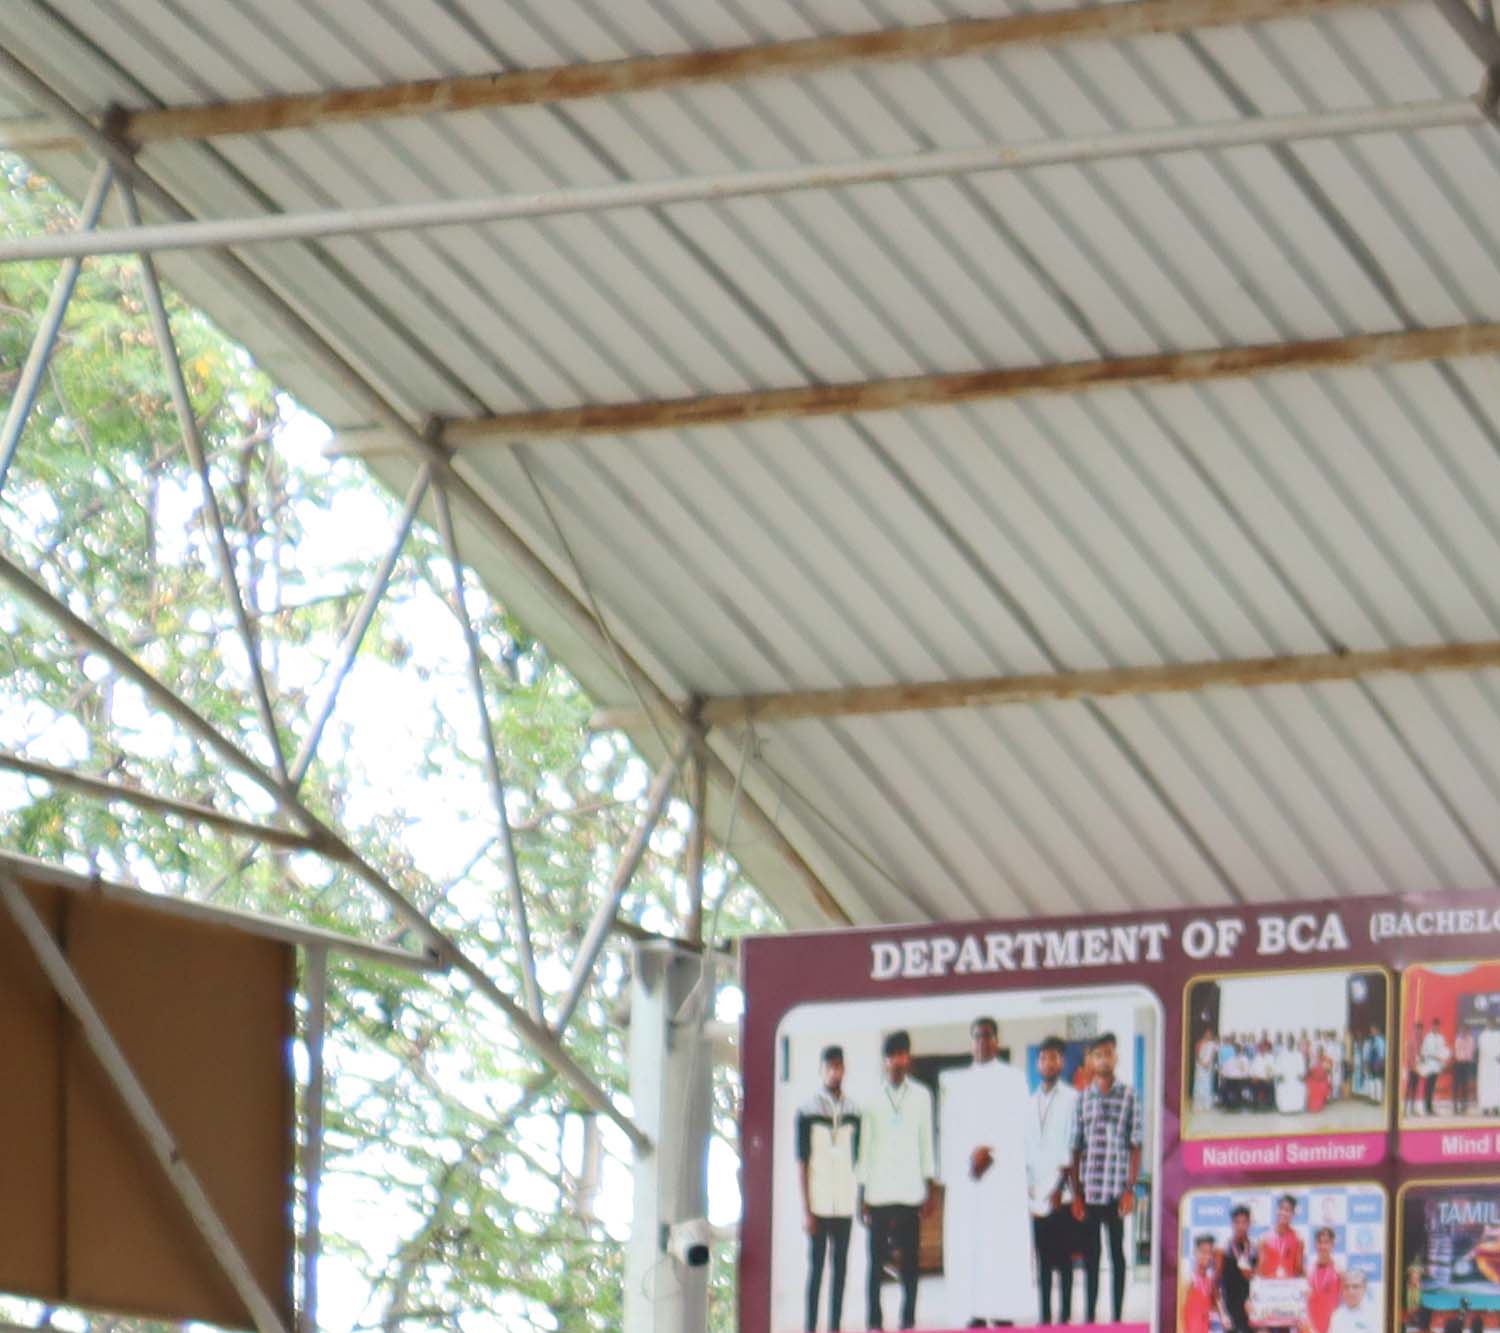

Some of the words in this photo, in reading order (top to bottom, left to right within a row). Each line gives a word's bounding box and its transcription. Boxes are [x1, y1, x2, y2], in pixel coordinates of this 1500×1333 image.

[870, 923, 1170, 981] DEPARTMENT
[1182, 918, 1244, 958] OF
[1256, 913, 1347, 953] BCA
[1203, 1144, 1281, 1167] National
[1286, 1140, 1367, 1164] Seminar
[1441, 1134, 1490, 1155] Mind
